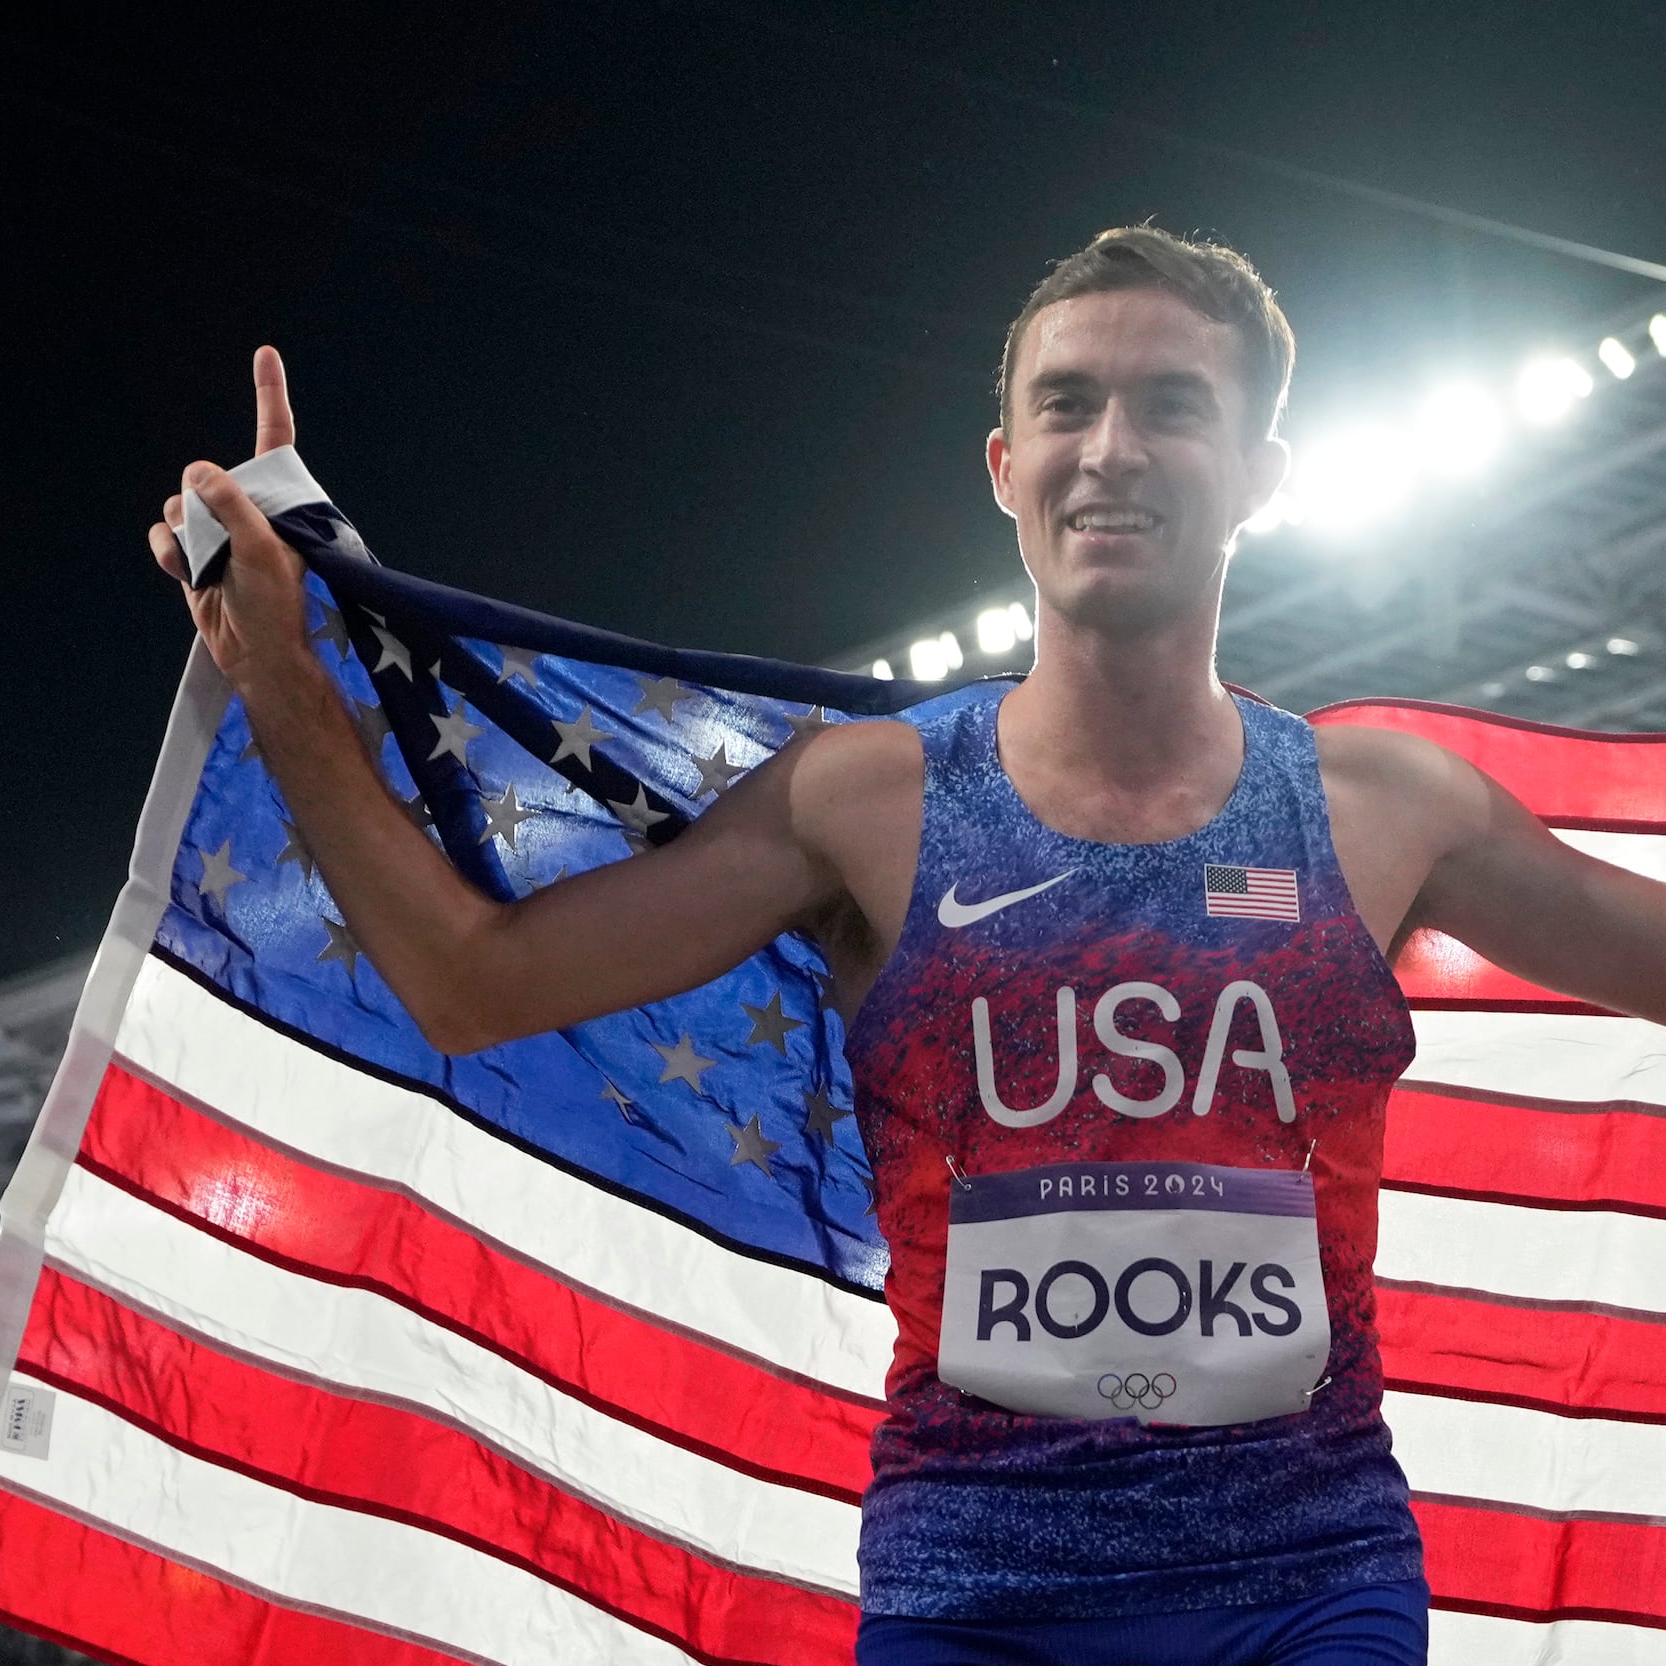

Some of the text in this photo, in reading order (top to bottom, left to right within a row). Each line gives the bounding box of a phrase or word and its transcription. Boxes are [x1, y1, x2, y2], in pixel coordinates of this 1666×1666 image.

[971, 980, 1297, 1128] USA
[1144, 1174, 1224, 1197] 2024
[976, 1257, 1302, 1341] ROOKS
